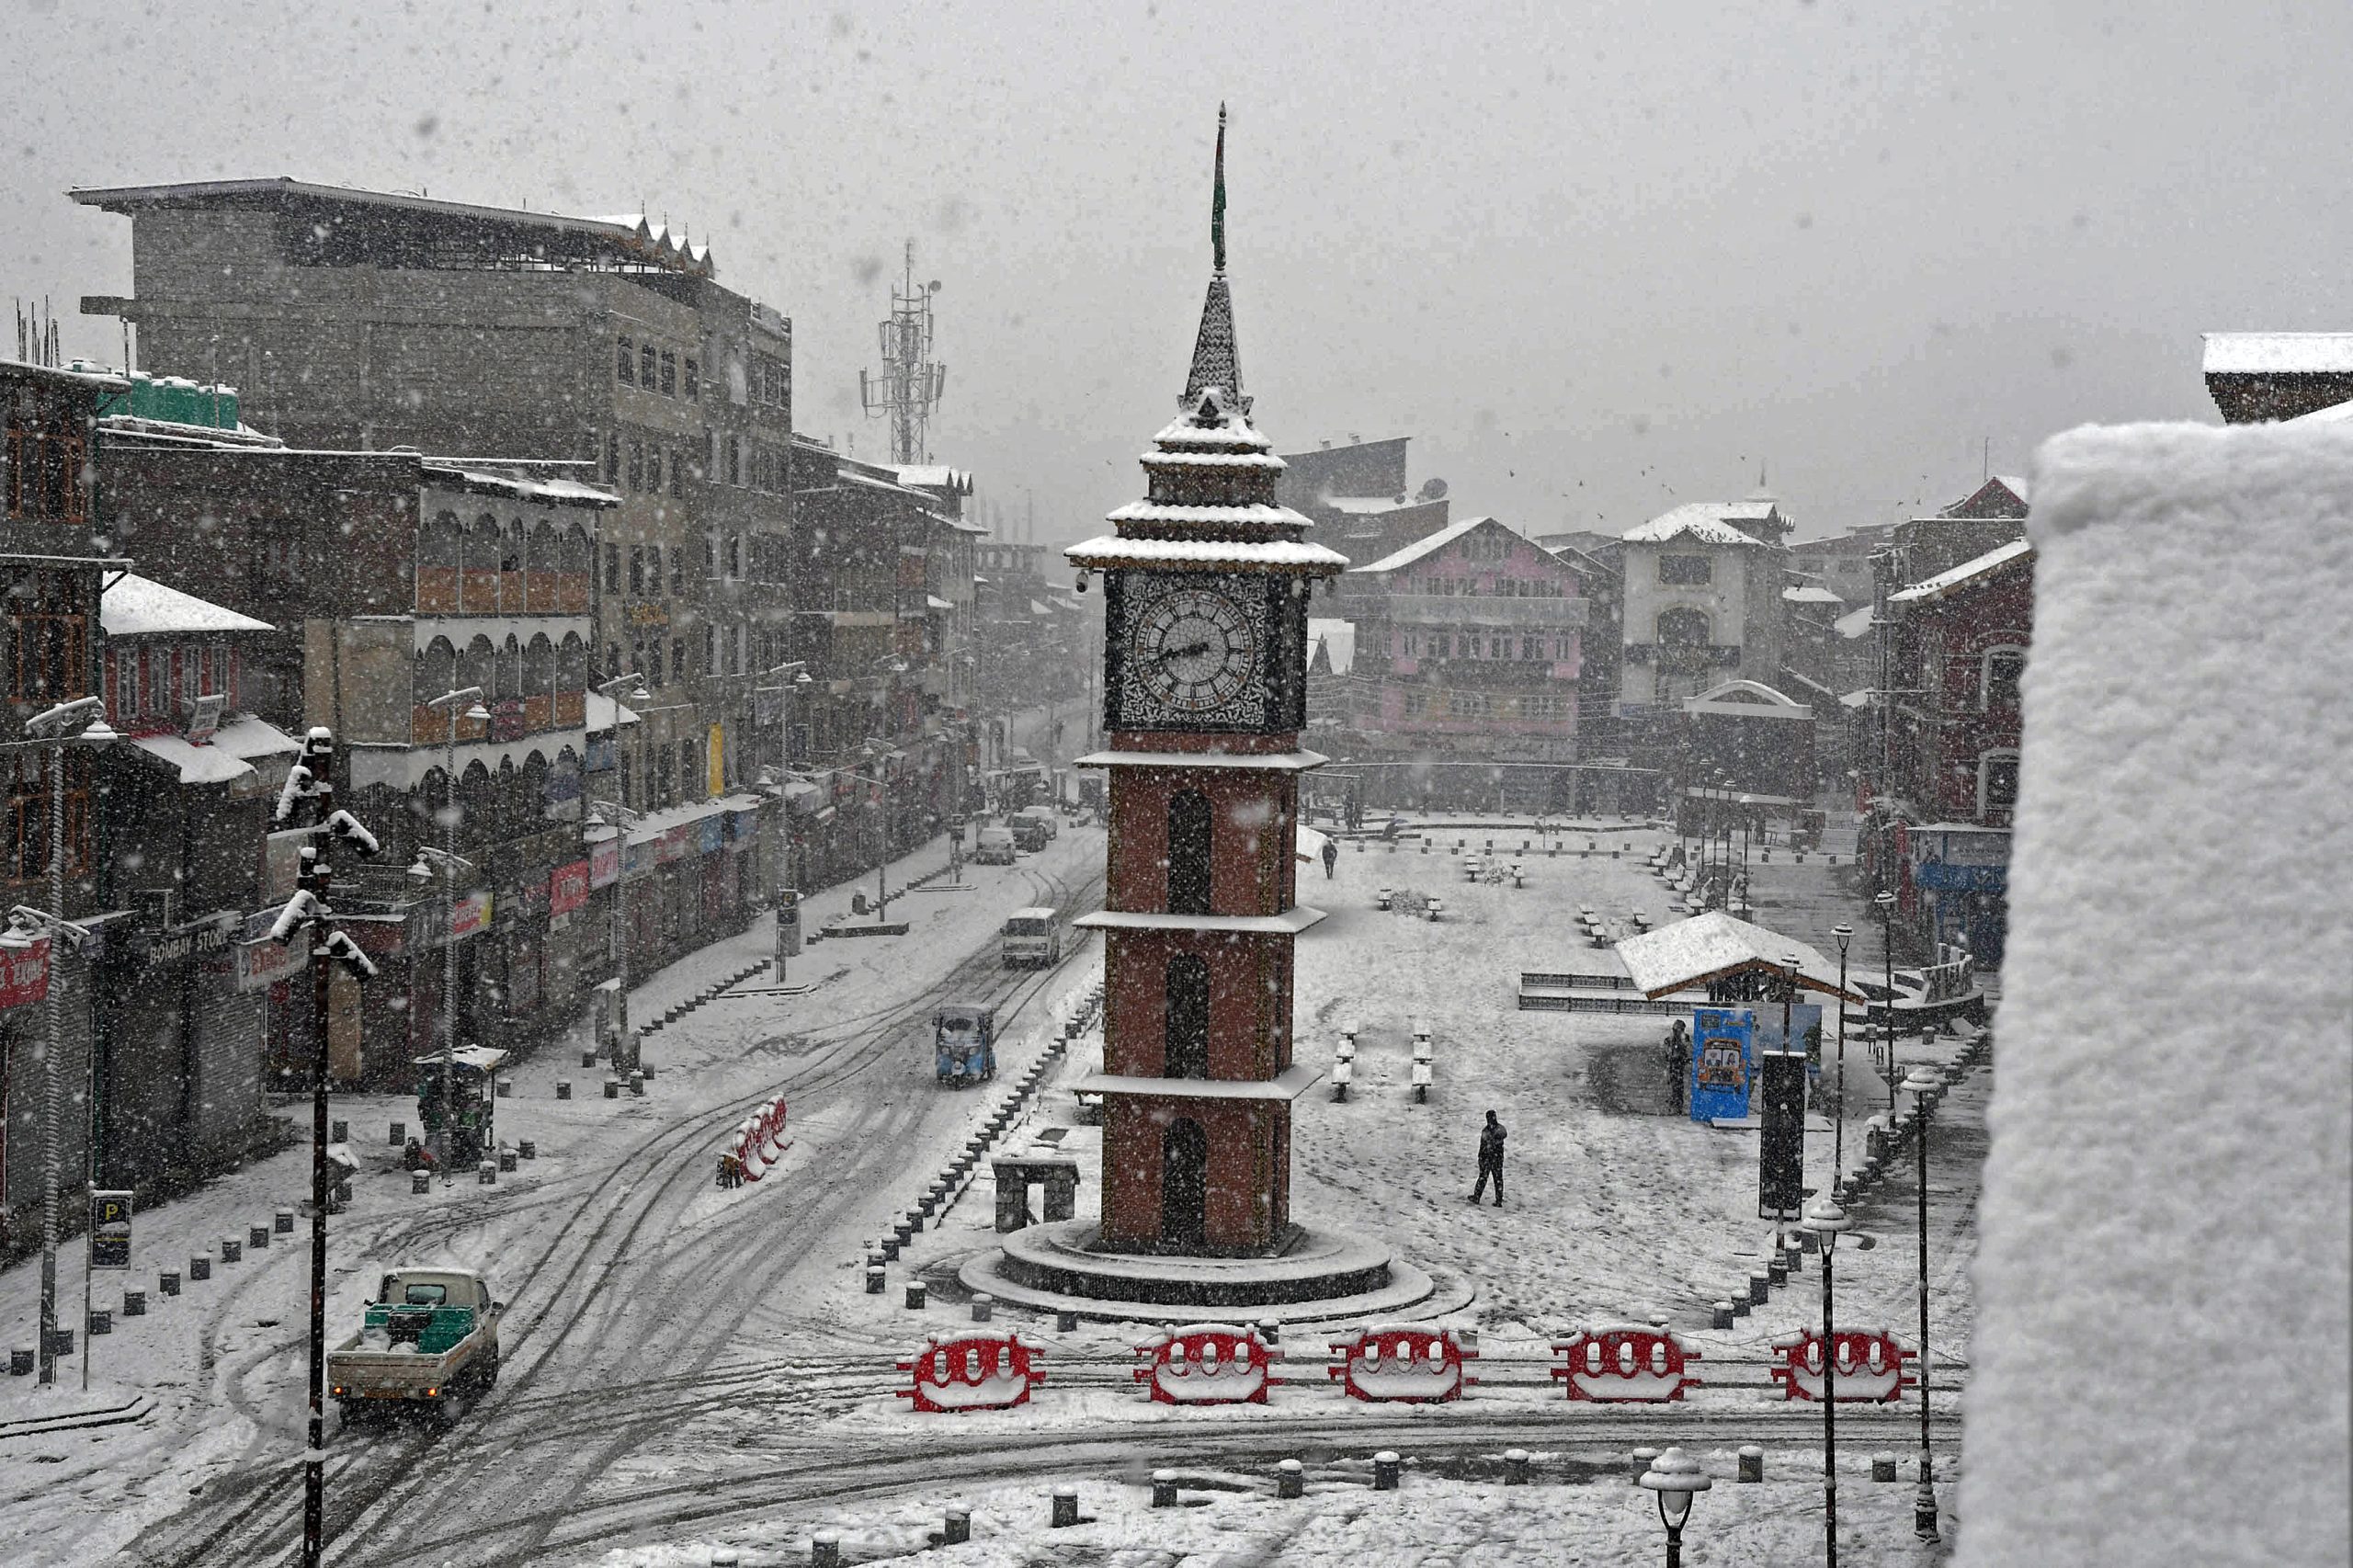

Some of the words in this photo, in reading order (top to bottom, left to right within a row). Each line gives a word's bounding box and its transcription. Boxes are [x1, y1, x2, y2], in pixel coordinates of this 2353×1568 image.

[150, 936, 193, 966] BOMBAY
[14, 958, 44, 986] EXIDE
[105, 1203, 119, 1221] P
